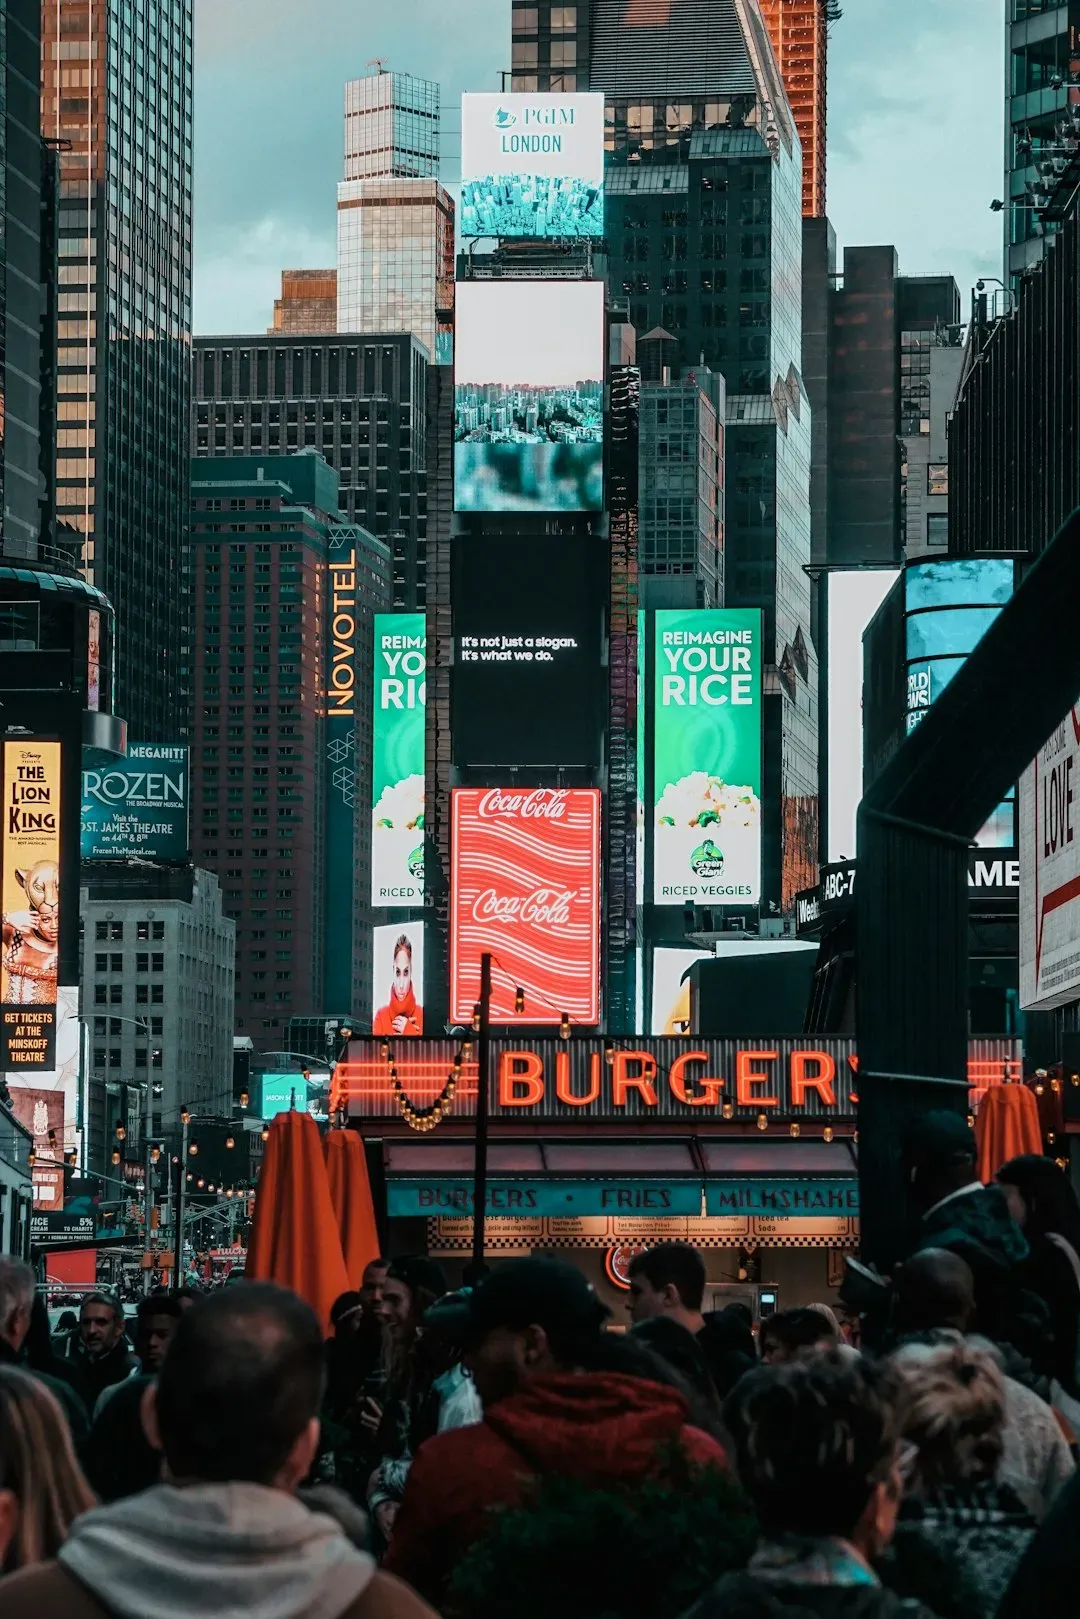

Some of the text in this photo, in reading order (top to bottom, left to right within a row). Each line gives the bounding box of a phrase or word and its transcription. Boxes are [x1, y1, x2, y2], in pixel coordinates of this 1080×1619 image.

[525, 108, 574, 124] PGIM
[502, 135, 562, 152] LONDON
[327, 549, 356, 716] NOVOTEL
[662, 630, 752, 645] REIMAGINE
[462, 636, 578, 650] It's not just a slogan.
[462, 650, 554, 661] It's what we do.
[664, 647, 752, 672] YOUR
[662, 674, 752, 706] RICE
[130, 746, 184, 759] MEGAHIT!
[17, 766, 44, 778] THE
[12, 782, 50, 804] LION
[479, 788, 572, 818] Coca-Cola
[1044, 754, 1073, 858] LOVE
[10, 806, 56, 833] KING
[112, 814, 138, 822] Visit the
[101, 822, 130, 832] JAMES
[133, 823, 173, 834] THEATRE
[129, 834, 135, 842] &
[694, 860, 723, 868] Green
[697, 868, 724, 876] Giant
[380, 888, 414, 897] RICED
[662, 886, 752, 895] RICED VEGGIES
[472, 888, 577, 923] Coca-Cola
[5, 1013, 52, 1023] GET TICKETS
[16, 1026, 41, 1036] AT THE
[9, 1039, 48, 1049] MINSKOFF
[11, 1052, 44, 1062] THEATRE
[500, 1050, 858, 1108] BURGER
[418, 1188, 537, 1208] BURERS
[600, 1188, 672, 1208] FRIES
[80, 1218, 93, 1226] 5%
[758, 1224, 776, 1232] Soda
